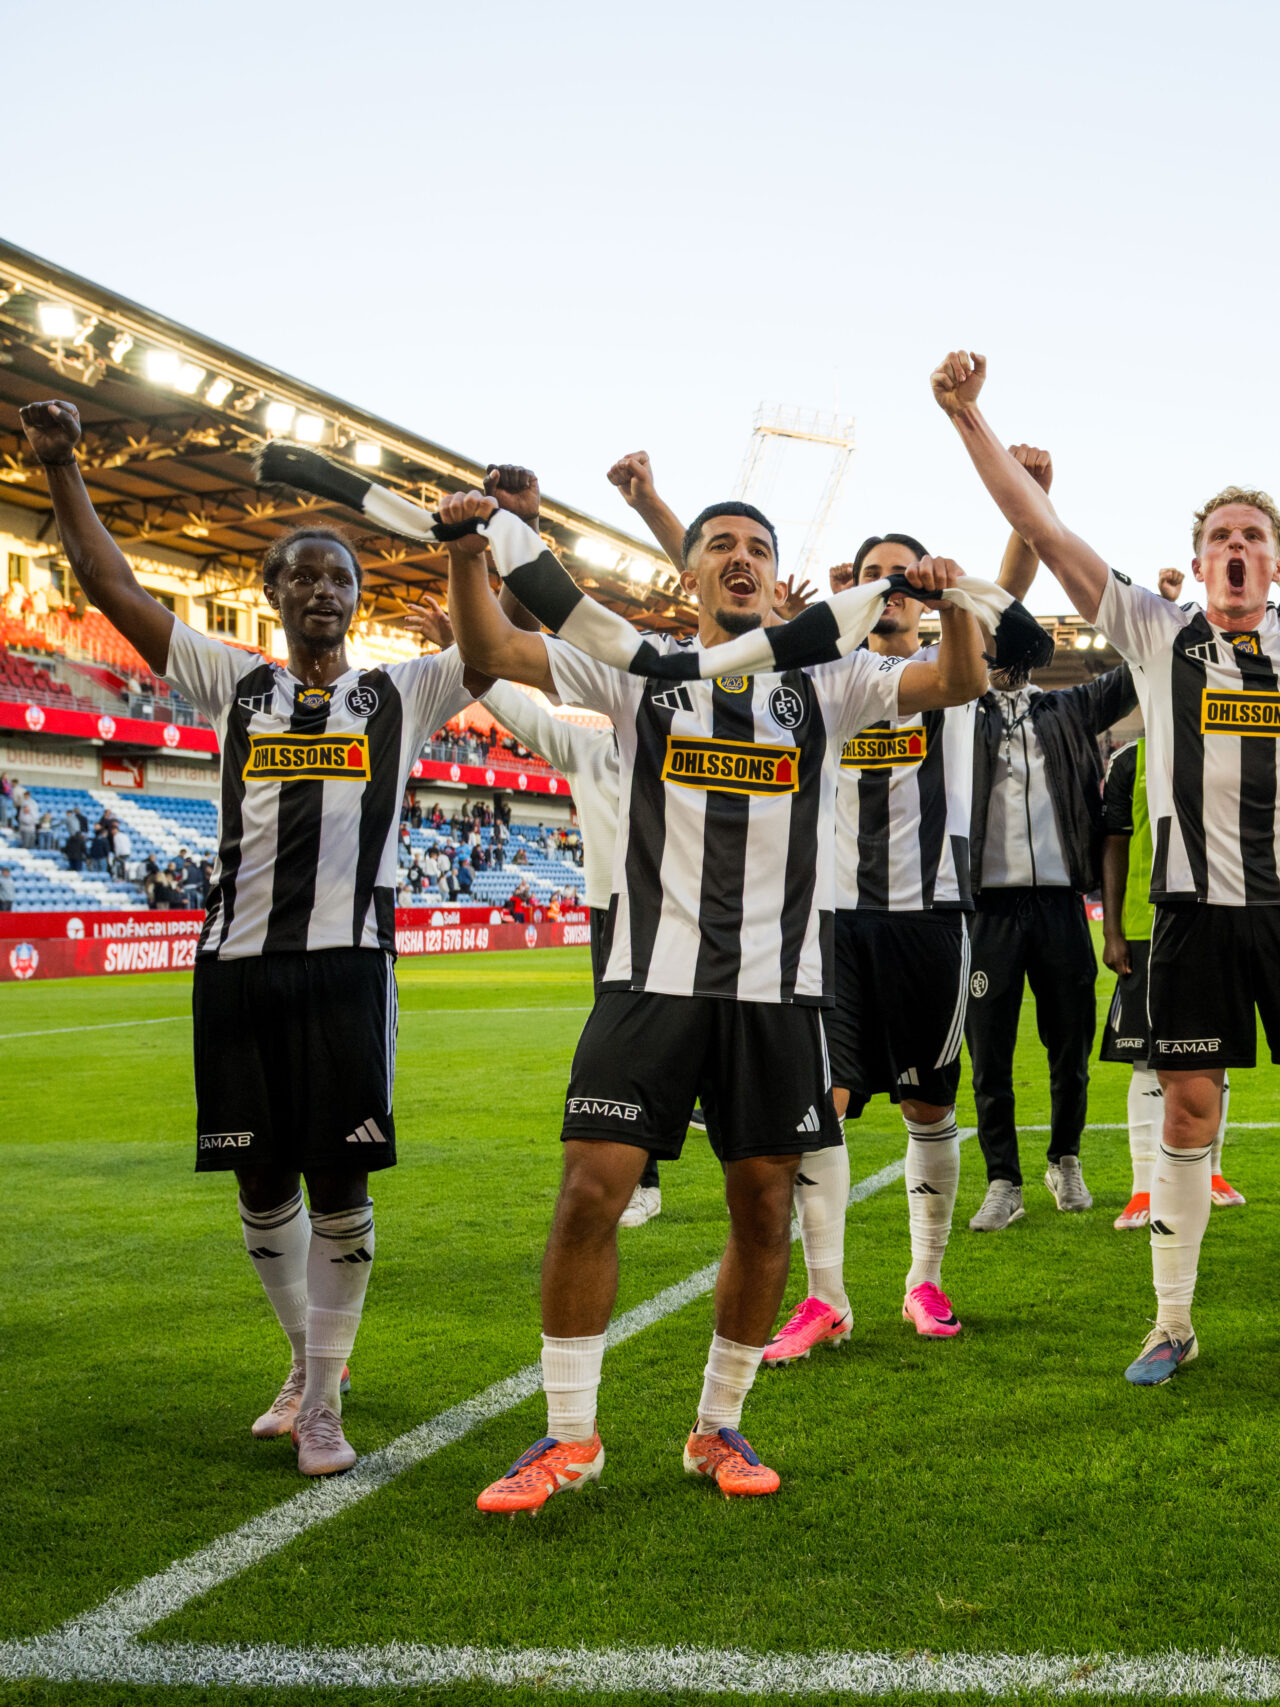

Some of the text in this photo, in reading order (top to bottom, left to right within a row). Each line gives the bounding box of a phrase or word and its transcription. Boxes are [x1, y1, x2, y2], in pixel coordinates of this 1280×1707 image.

[253, 746, 346, 768] OHLSSONS
[671, 751, 775, 782] OHLSSONS
[425, 929, 442, 952] 123
[443, 928, 463, 951] 576
[463, 927, 476, 950] 64
[476, 927, 489, 949] 49
[104, 938, 197, 972] SWISHA 123
